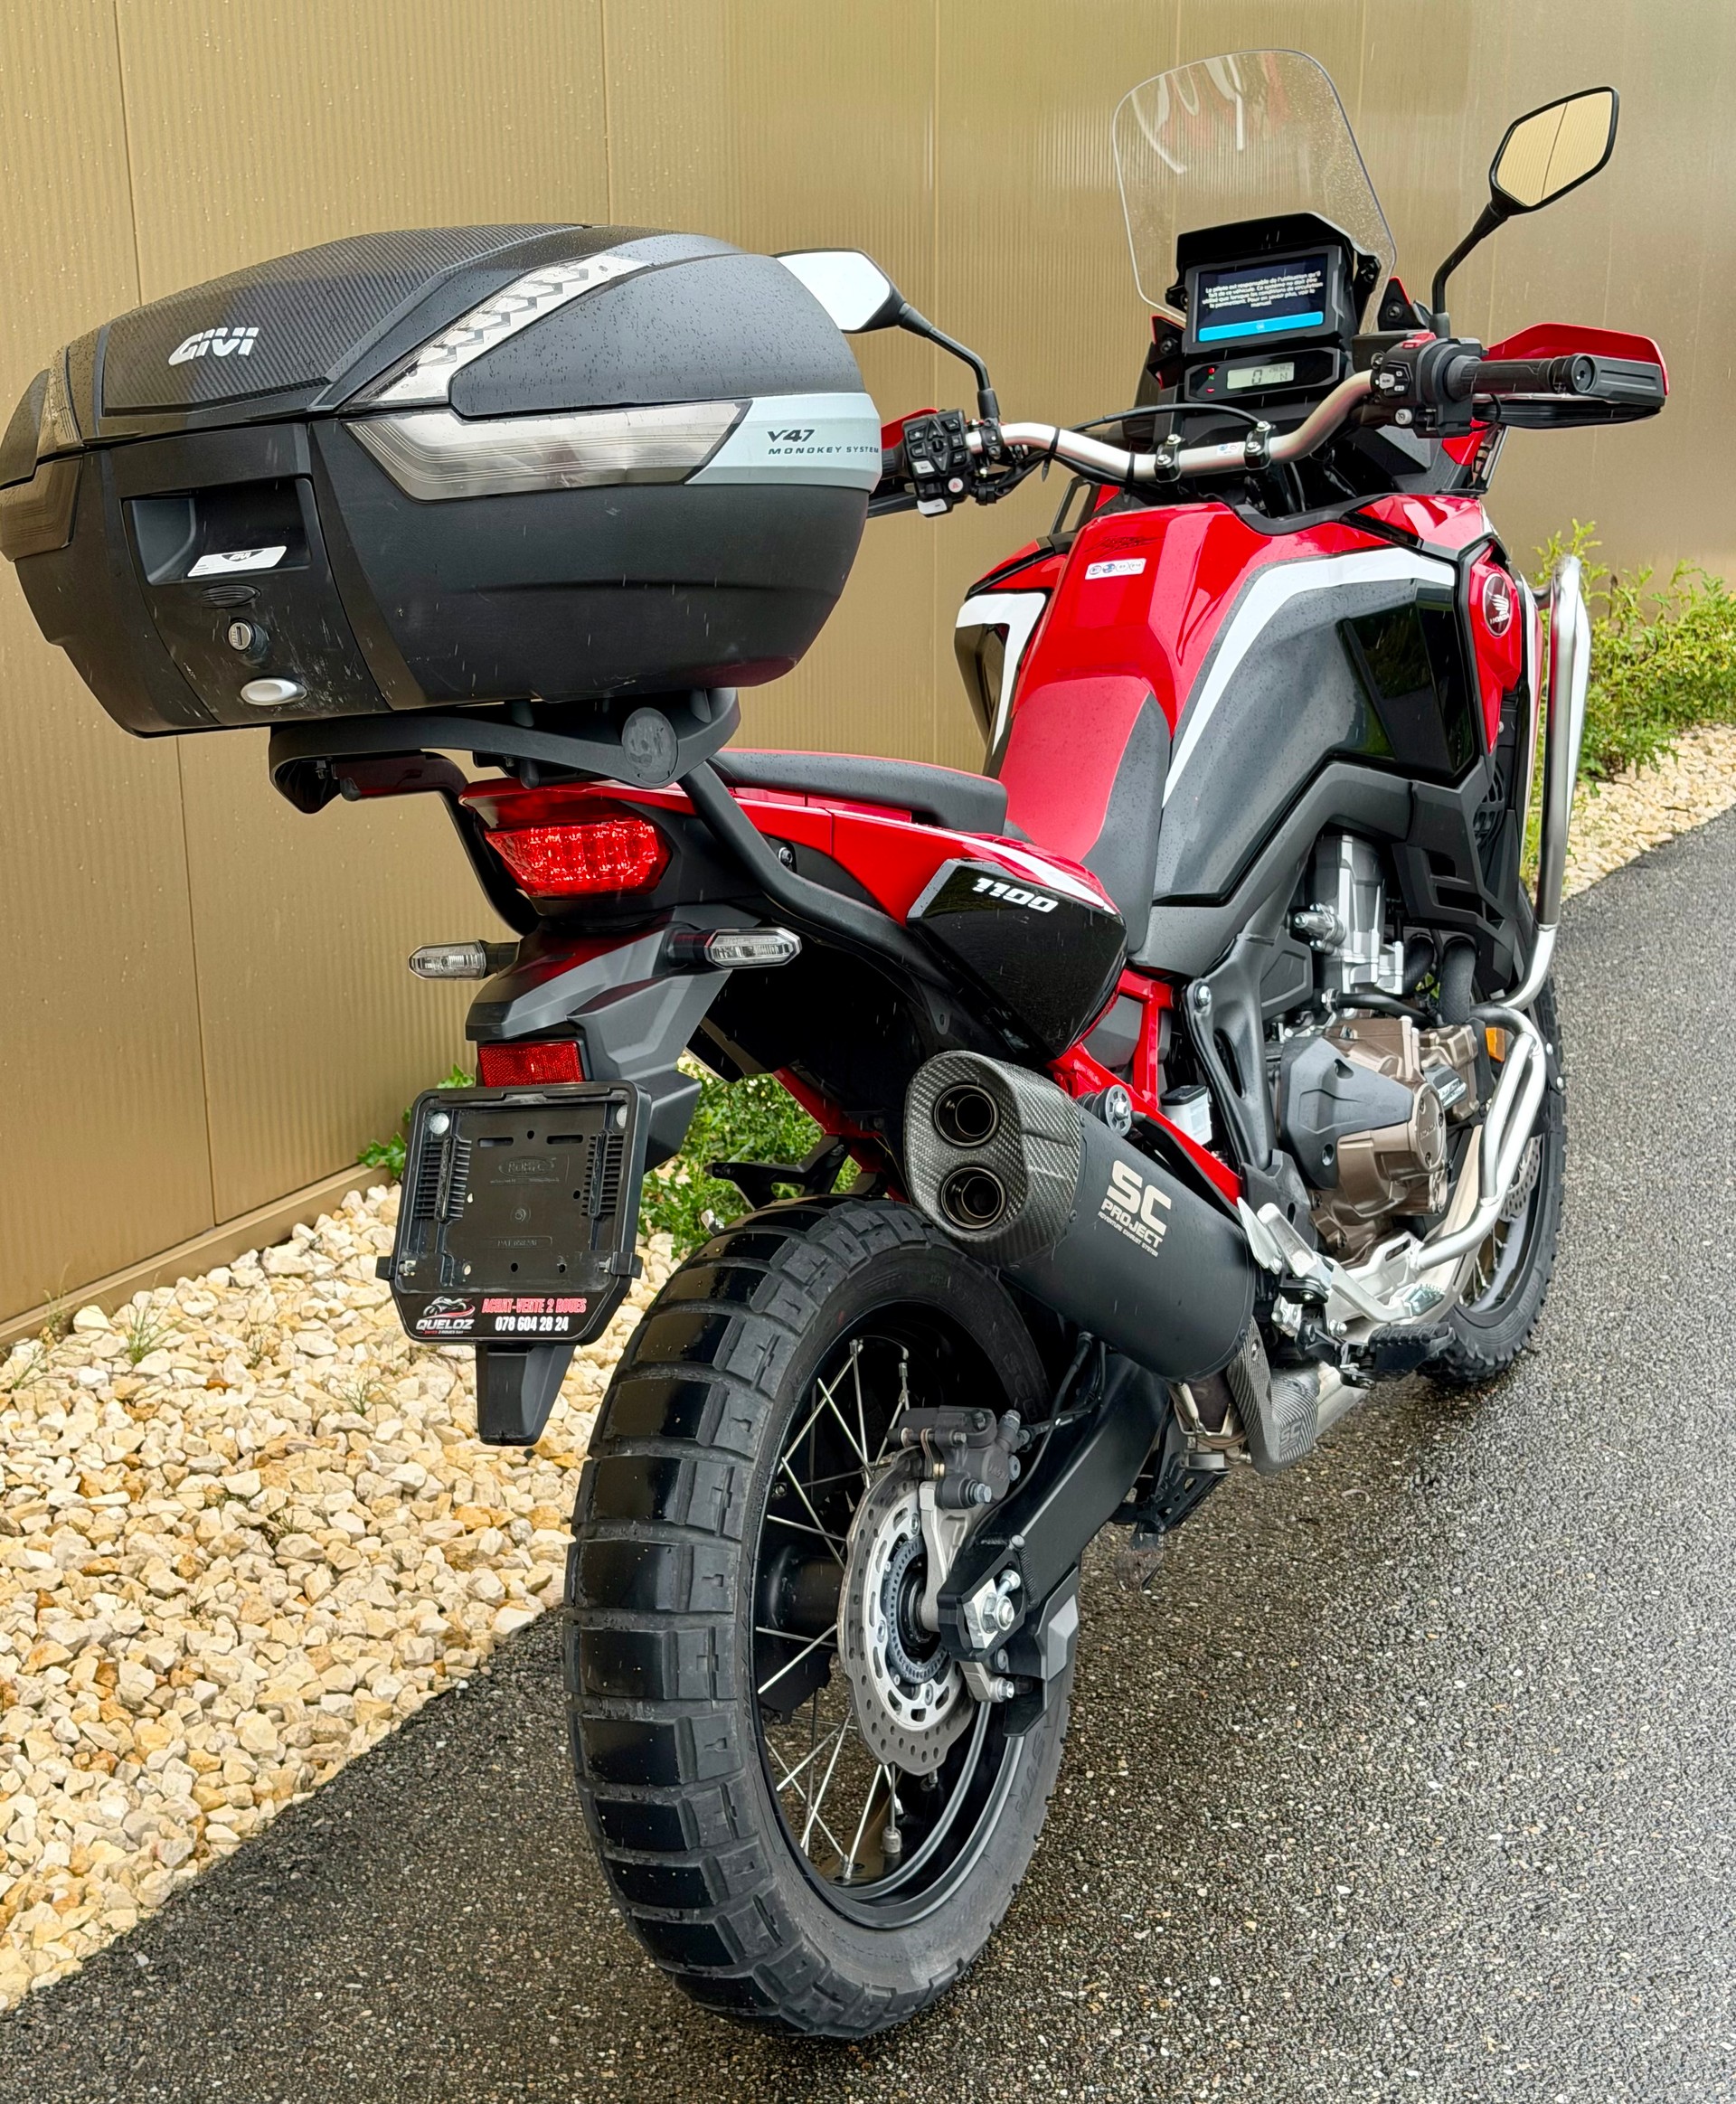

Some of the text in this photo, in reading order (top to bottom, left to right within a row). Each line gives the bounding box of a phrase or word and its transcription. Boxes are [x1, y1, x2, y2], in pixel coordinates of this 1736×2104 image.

[1237, 279, 1268, 288] responsable
[1258, 287, 1285, 295] conditions
[1294, 282, 1322, 290] circulation
[168, 327, 259, 366] GIVI
[767, 429, 816, 443] V47
[768, 446, 843, 455] MONOKEY
[972, 877, 1059, 913] 1100
[1106, 1159, 1172, 1237] SC
[1100, 1198, 1164, 1249] PROJECT
[546, 1298, 555, 1313] 2
[415, 1319, 475, 1330] QUELOZ
[495, 1316, 569, 1331] 078 604 28 24
